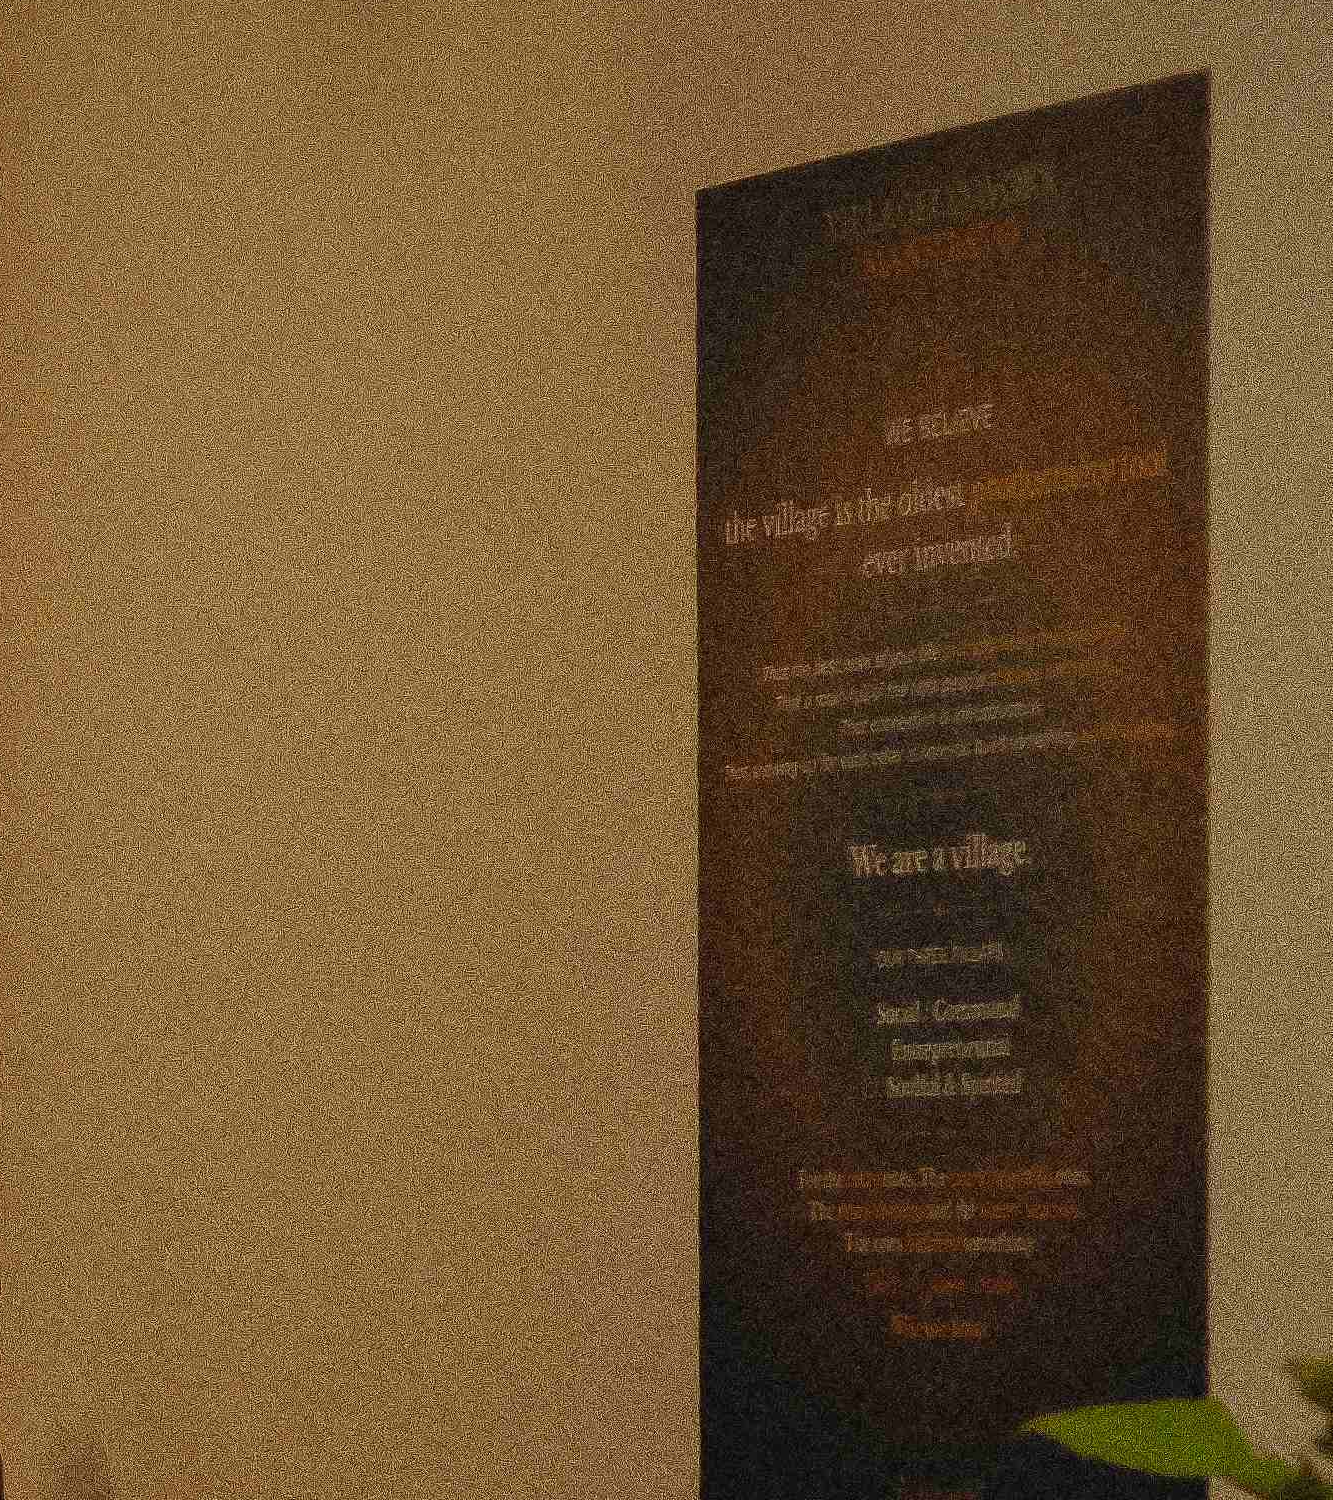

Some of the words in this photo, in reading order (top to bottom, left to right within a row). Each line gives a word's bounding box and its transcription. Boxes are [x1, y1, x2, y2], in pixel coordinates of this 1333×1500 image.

[919, 402, 994, 441] BELIEVE
[724, 509, 755, 544] the
[762, 500, 830, 541] village
[857, 488, 891, 523] the
[862, 545, 909, 579] ever
[849, 843, 887, 878] We
[891, 847, 927, 875] are
[932, 847, 945, 872] a
